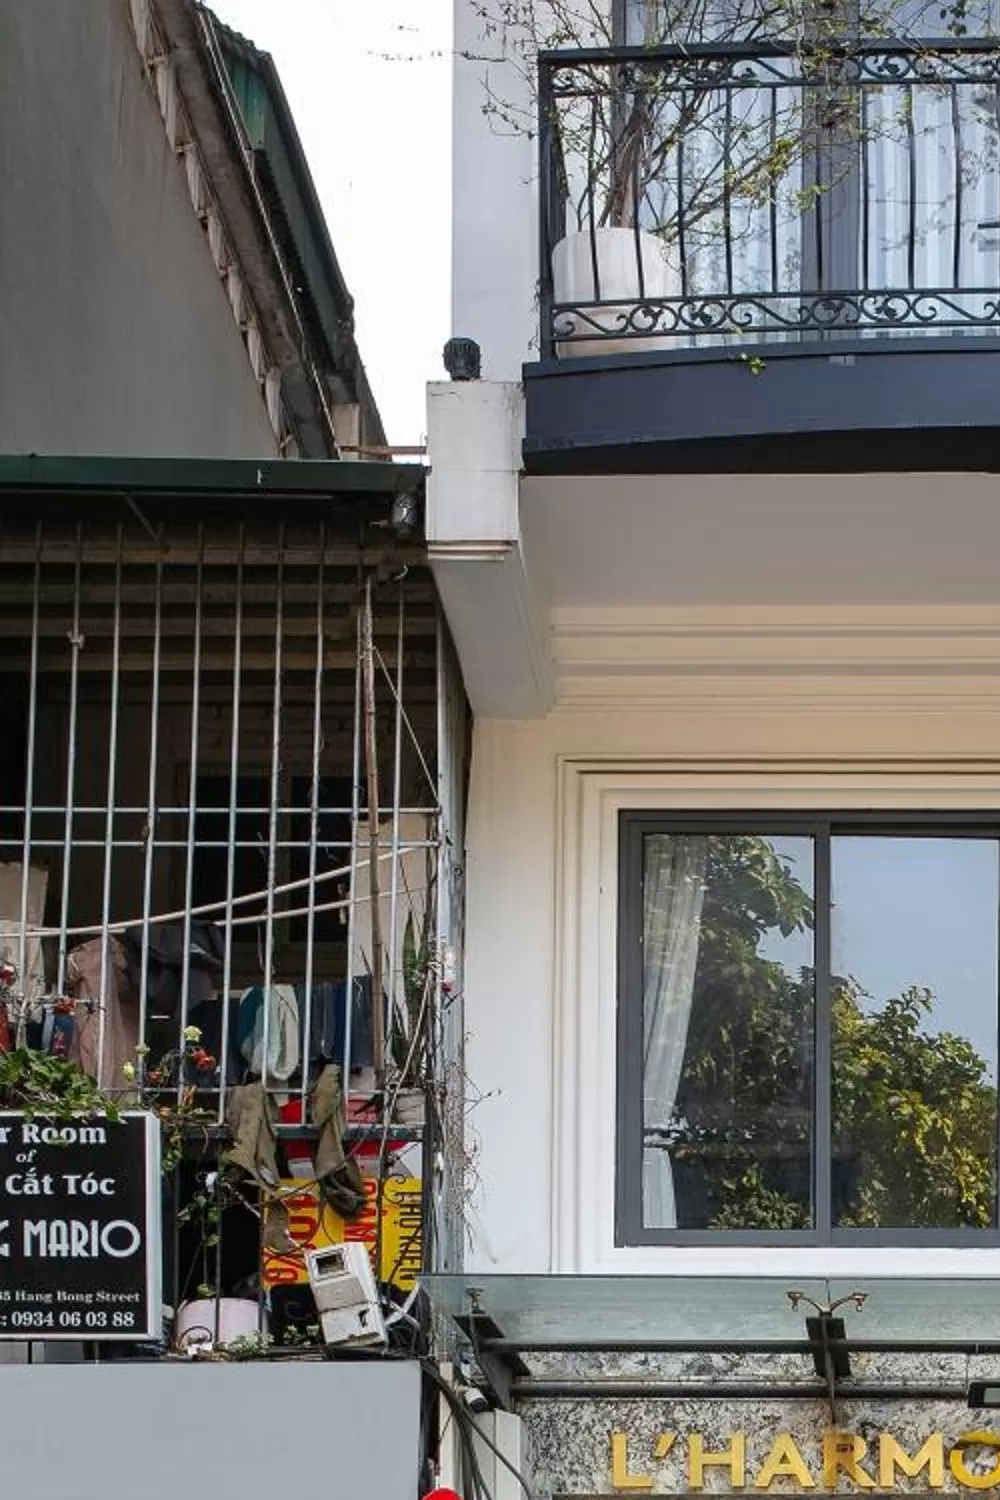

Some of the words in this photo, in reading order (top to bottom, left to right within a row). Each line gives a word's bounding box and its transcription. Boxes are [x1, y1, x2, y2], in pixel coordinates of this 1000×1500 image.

[22, 1123, 107, 1144] Room
[16, 1149, 37, 1163] of
[5, 1167, 55, 1195] Cắt
[62, 1171, 116, 1195] Tóc
[23, 1219, 141, 1258] MARIO
[95, 1290, 140, 1302] Street
[11, 1311, 54, 1327] 0934
[59, 1311, 81, 1327] 06
[85, 1311, 107, 1327] 03
[112, 1311, 135, 1327] 88
